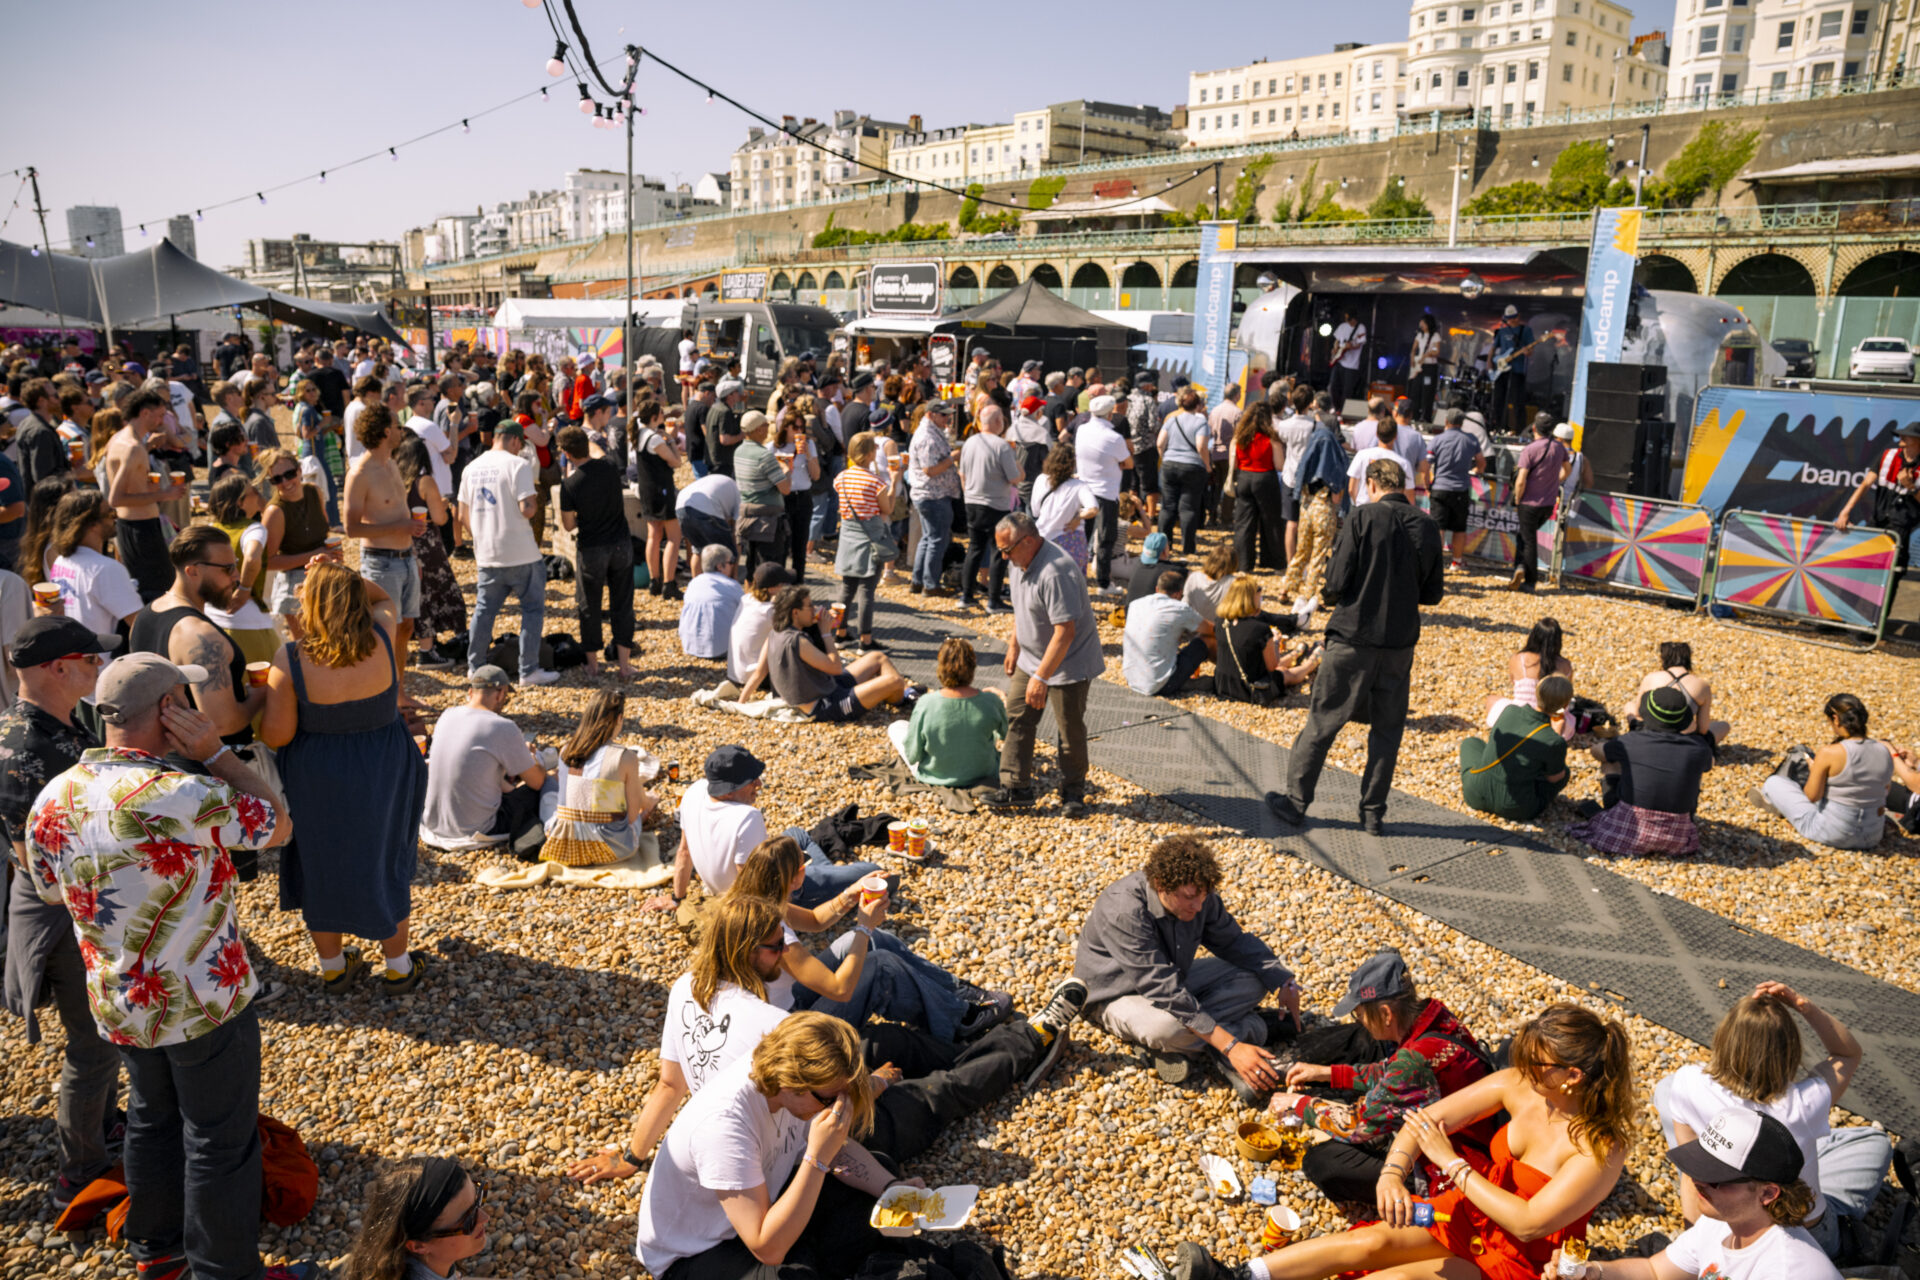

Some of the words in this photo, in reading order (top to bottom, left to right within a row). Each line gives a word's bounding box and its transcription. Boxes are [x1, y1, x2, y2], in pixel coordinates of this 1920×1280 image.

[1203, 266, 1224, 355] bandcamp
[1594, 269, 1621, 363] ndcamp
[1801, 461, 1876, 489] band
[1466, 515, 1521, 533] ESCAP
[1488, 507, 1520, 522] GRE
